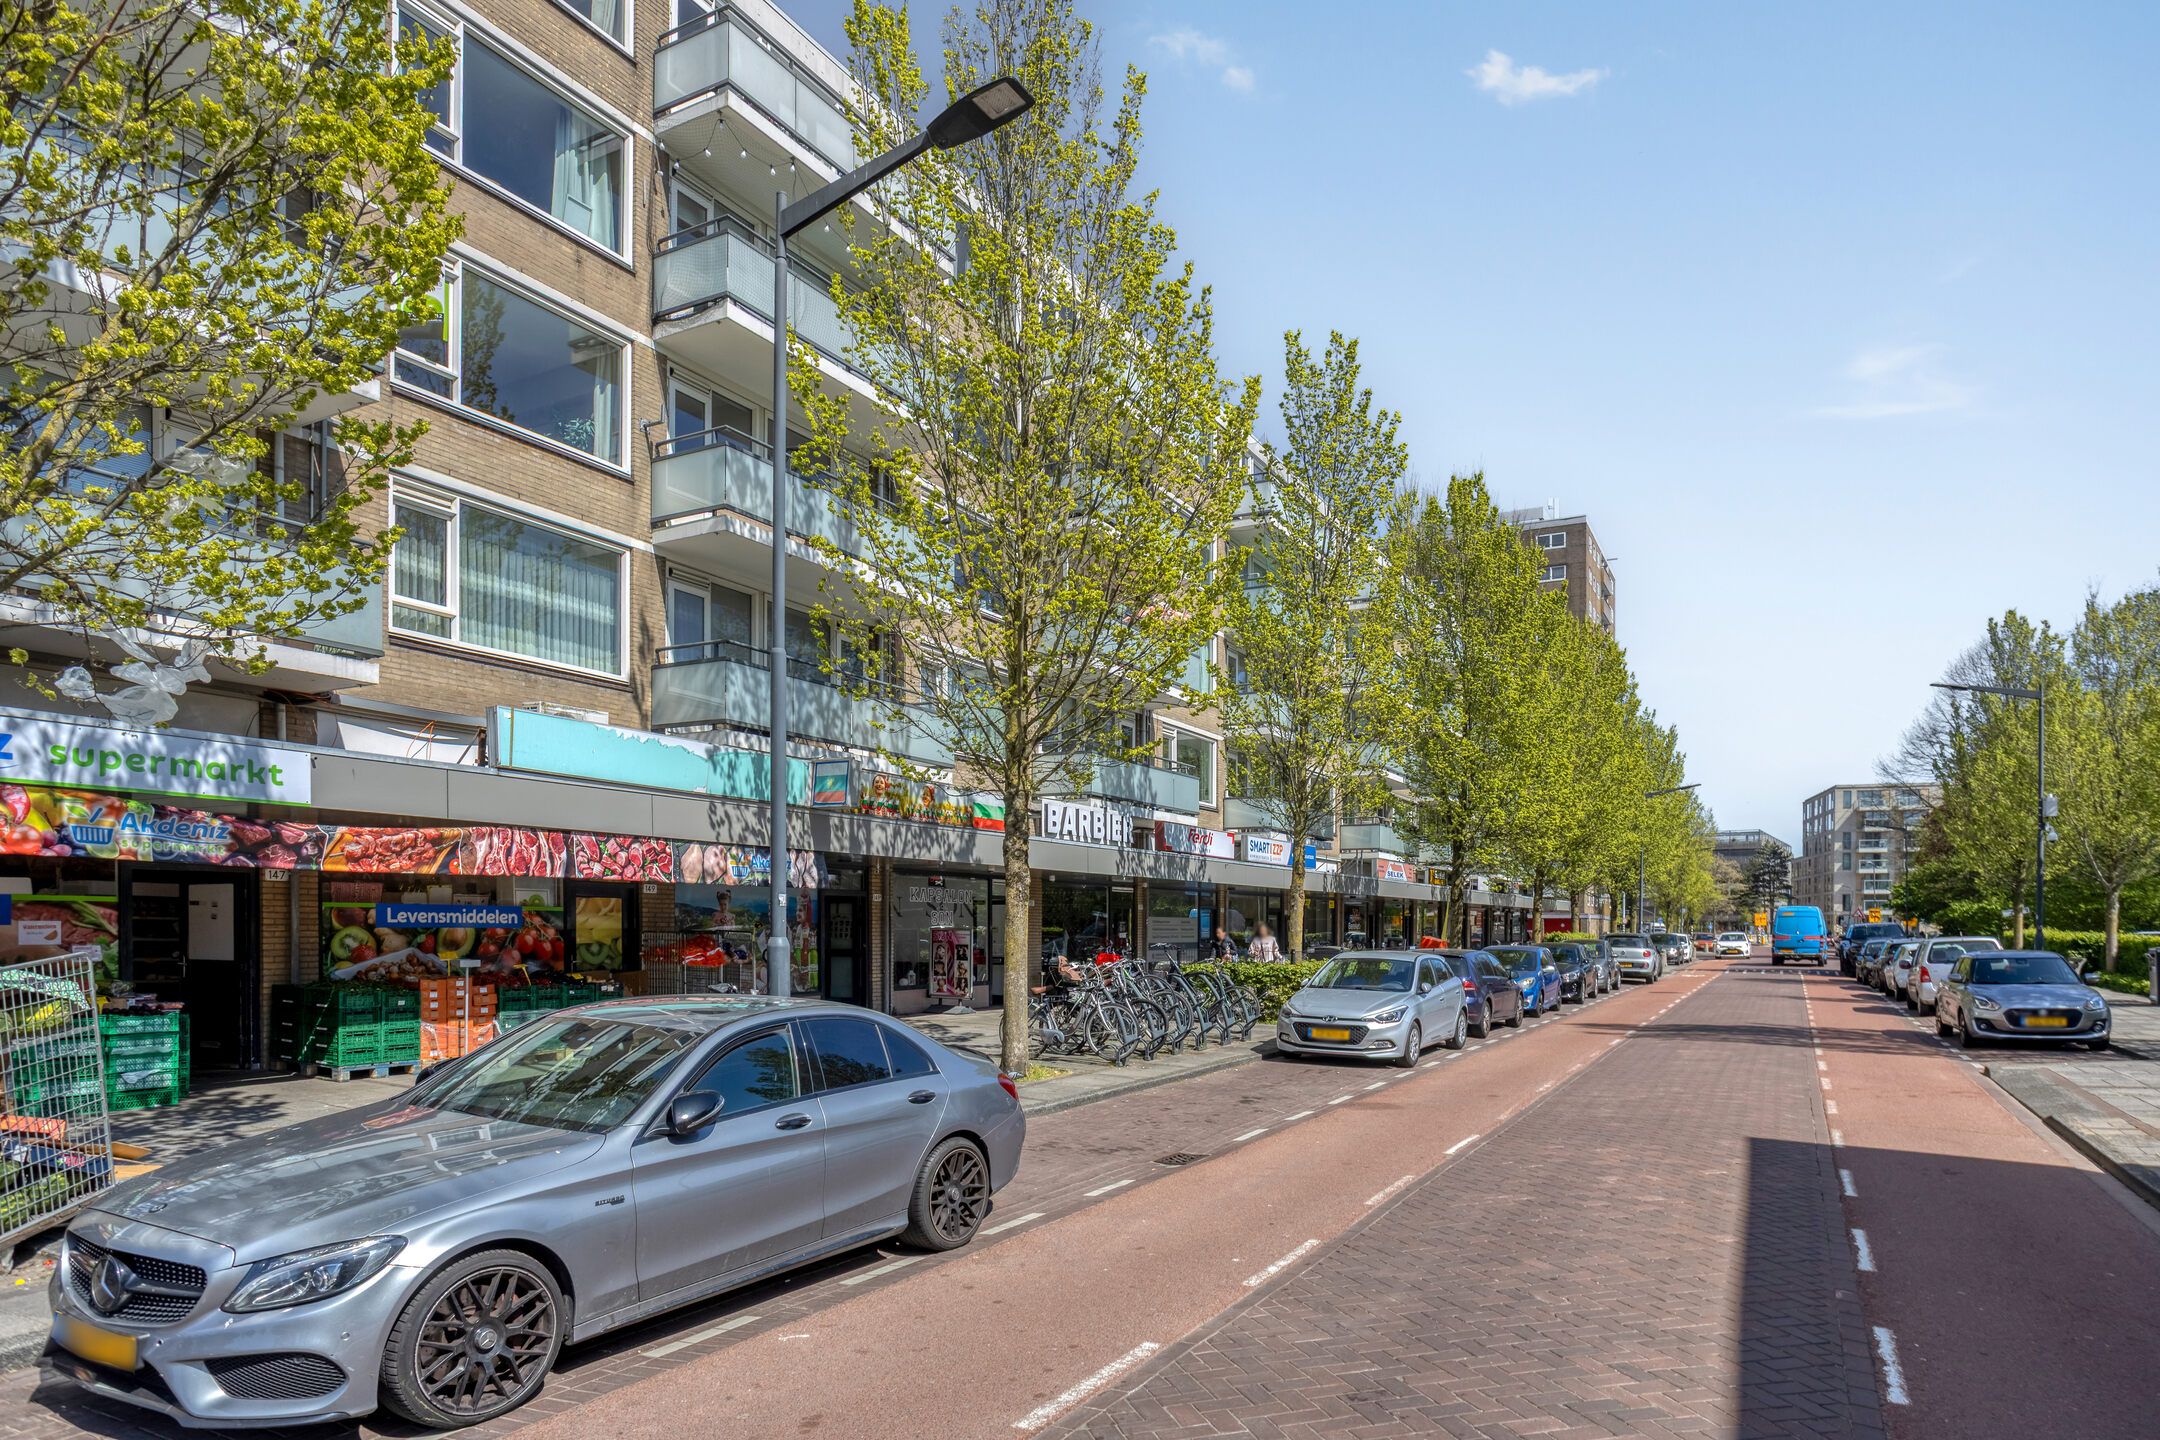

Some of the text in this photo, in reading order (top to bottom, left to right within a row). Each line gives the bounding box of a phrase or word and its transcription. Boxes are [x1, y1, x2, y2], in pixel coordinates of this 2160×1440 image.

[49, 744, 284, 787] supermarkt
[120, 812, 230, 840] Akdeniz
[1046, 801, 1134, 845] BARBIER
[1188, 828, 1214, 846] Ferdi
[121, 840, 226, 855] supermarkt
[1249, 839, 1284, 856] SMART ZZP
[268, 870, 285, 880] 147
[1387, 870, 1404, 878] SELEK
[909, 886, 973, 904] KAPSALON
[386, 907, 518, 924] Levensmiddelen
[930, 910, 954, 926] SON
